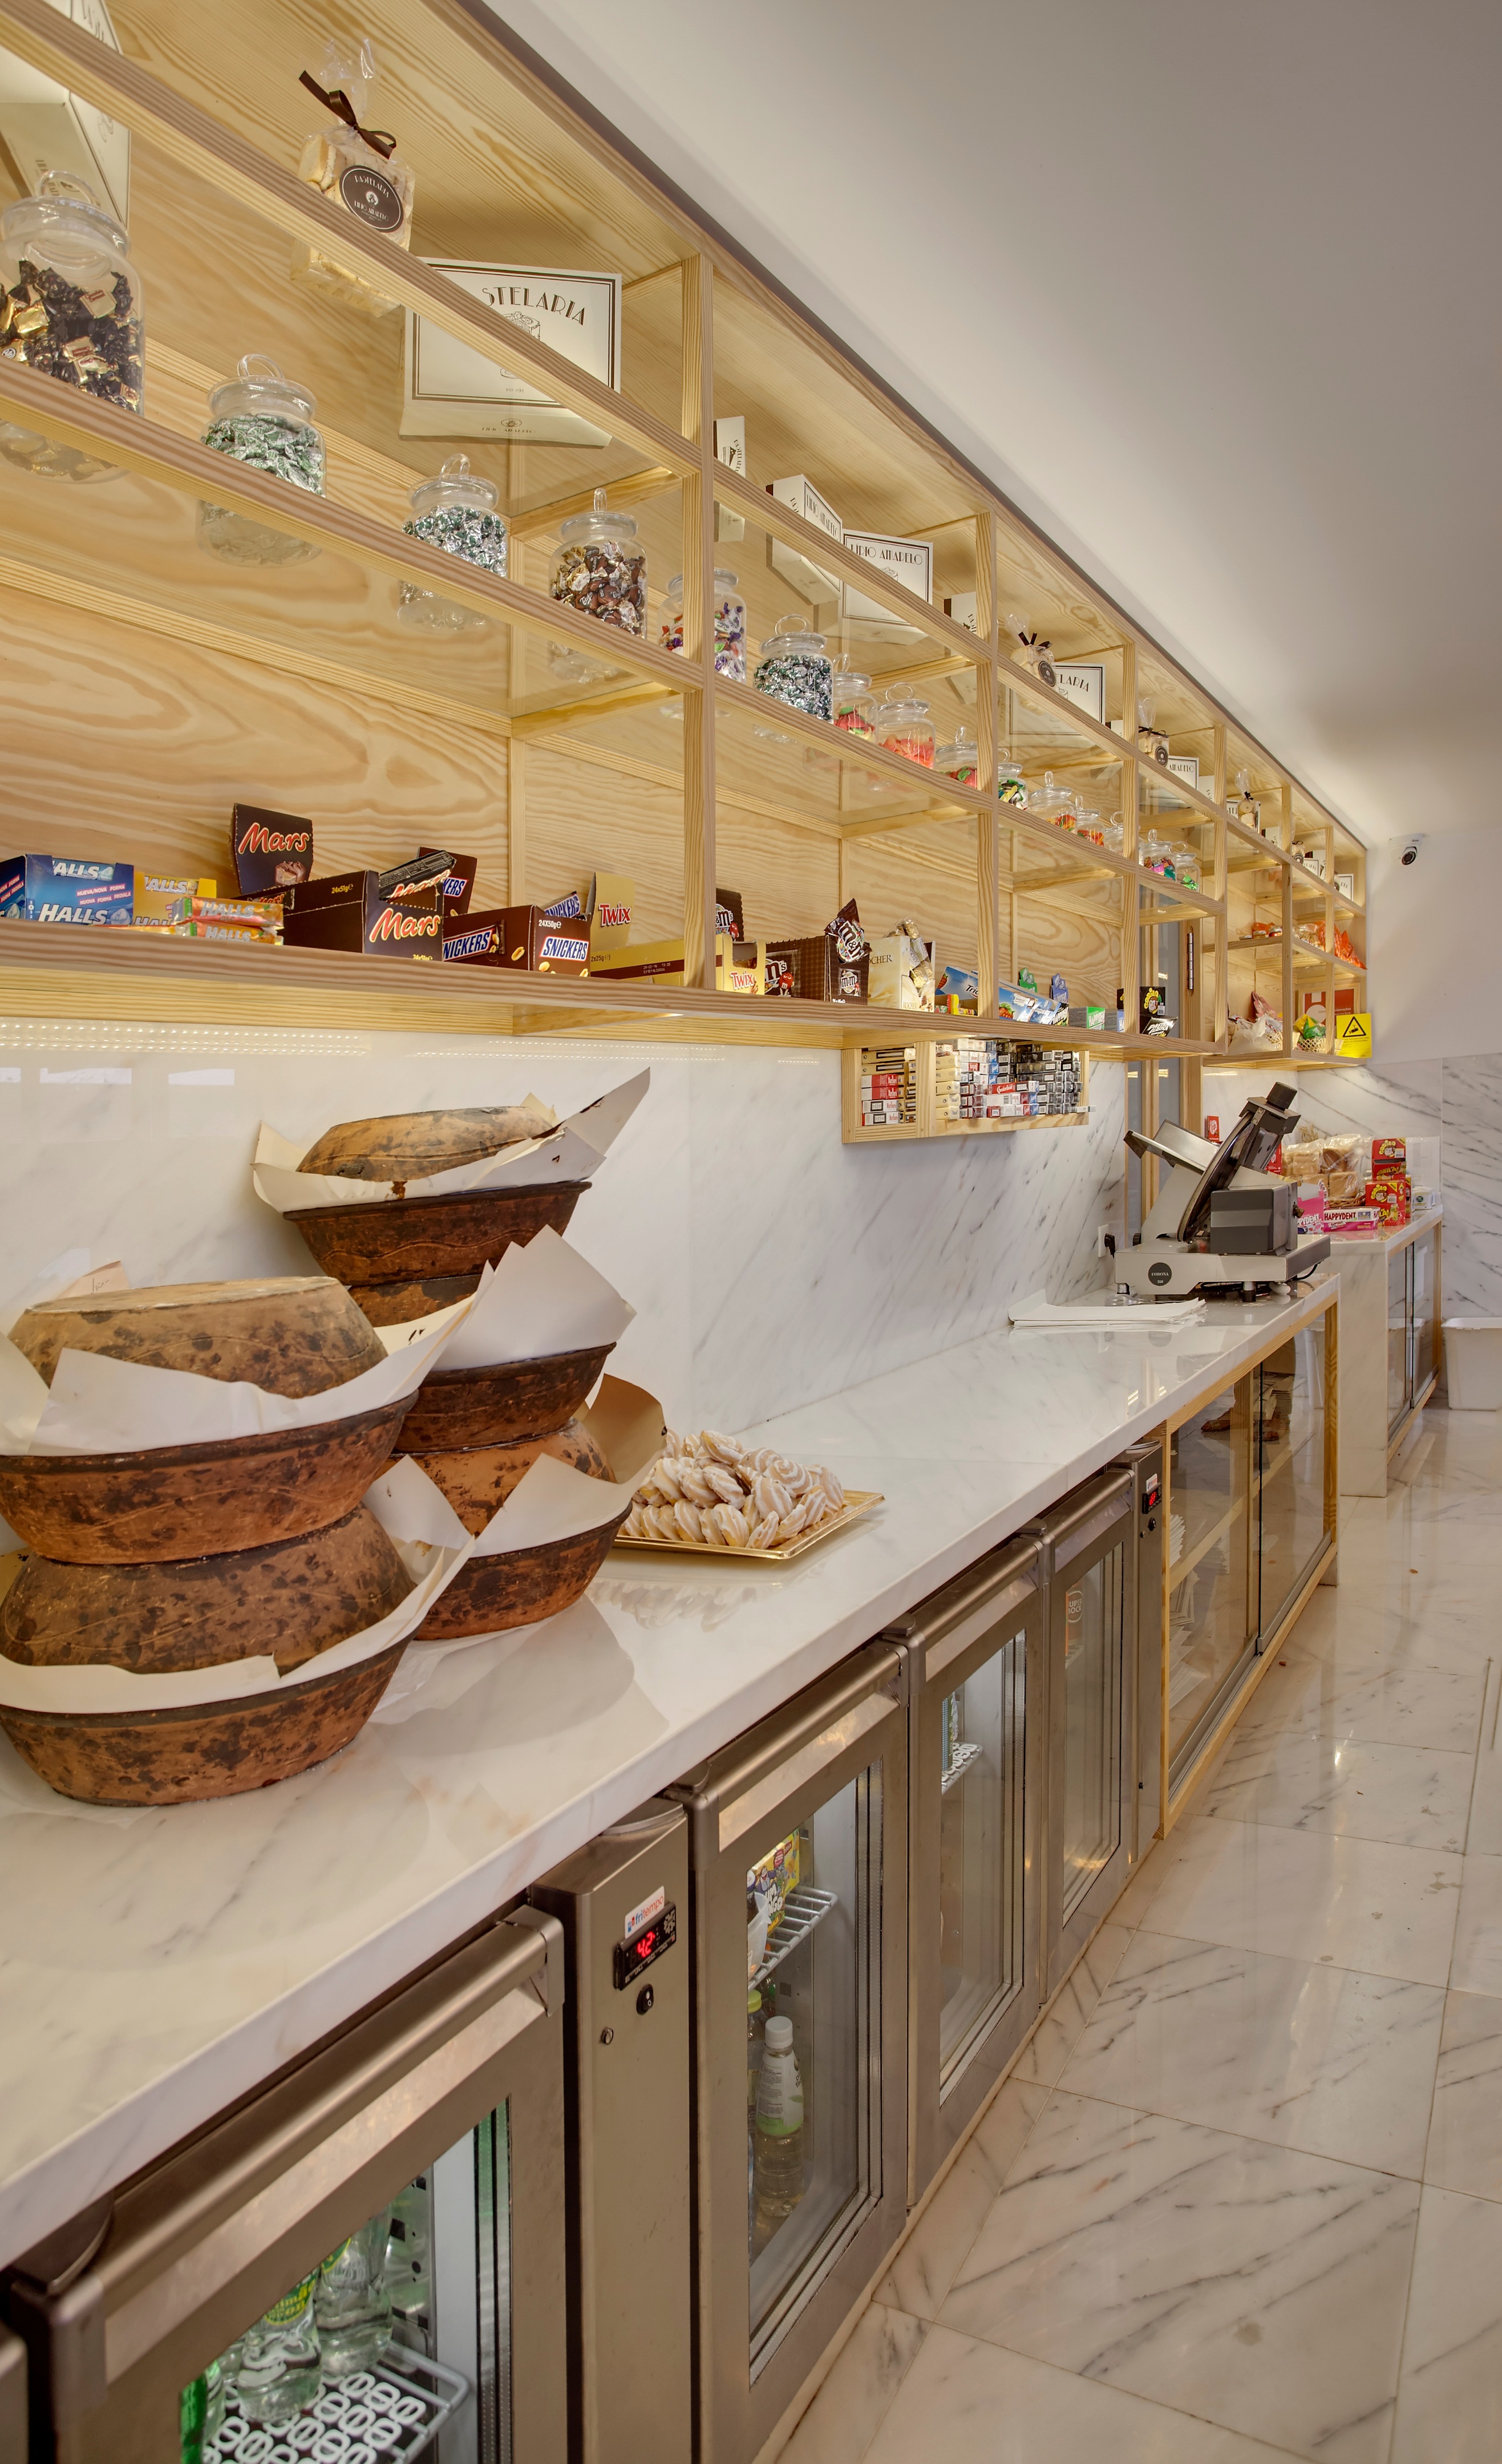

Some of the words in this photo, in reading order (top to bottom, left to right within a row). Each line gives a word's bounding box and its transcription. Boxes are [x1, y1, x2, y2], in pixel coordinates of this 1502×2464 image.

[482, 286, 585, 326] STELARIA
[880, 549, 923, 565] AMARELO
[238, 822, 309, 854] Mars
[54, 860, 100, 880] ALLS
[38, 903, 109, 925] HALLS
[200, 900, 256, 918] HALLS
[599, 902, 632, 927] Twix
[369, 907, 441, 943] Mars
[443, 931, 491, 960] NICKERS
[542, 937, 588, 961] SNICKERS
[730, 971, 755, 990] Twix
[1324, 1212, 1356, 1221] HAPPYDENT
[635, 1896, 664, 1925] fritempo
